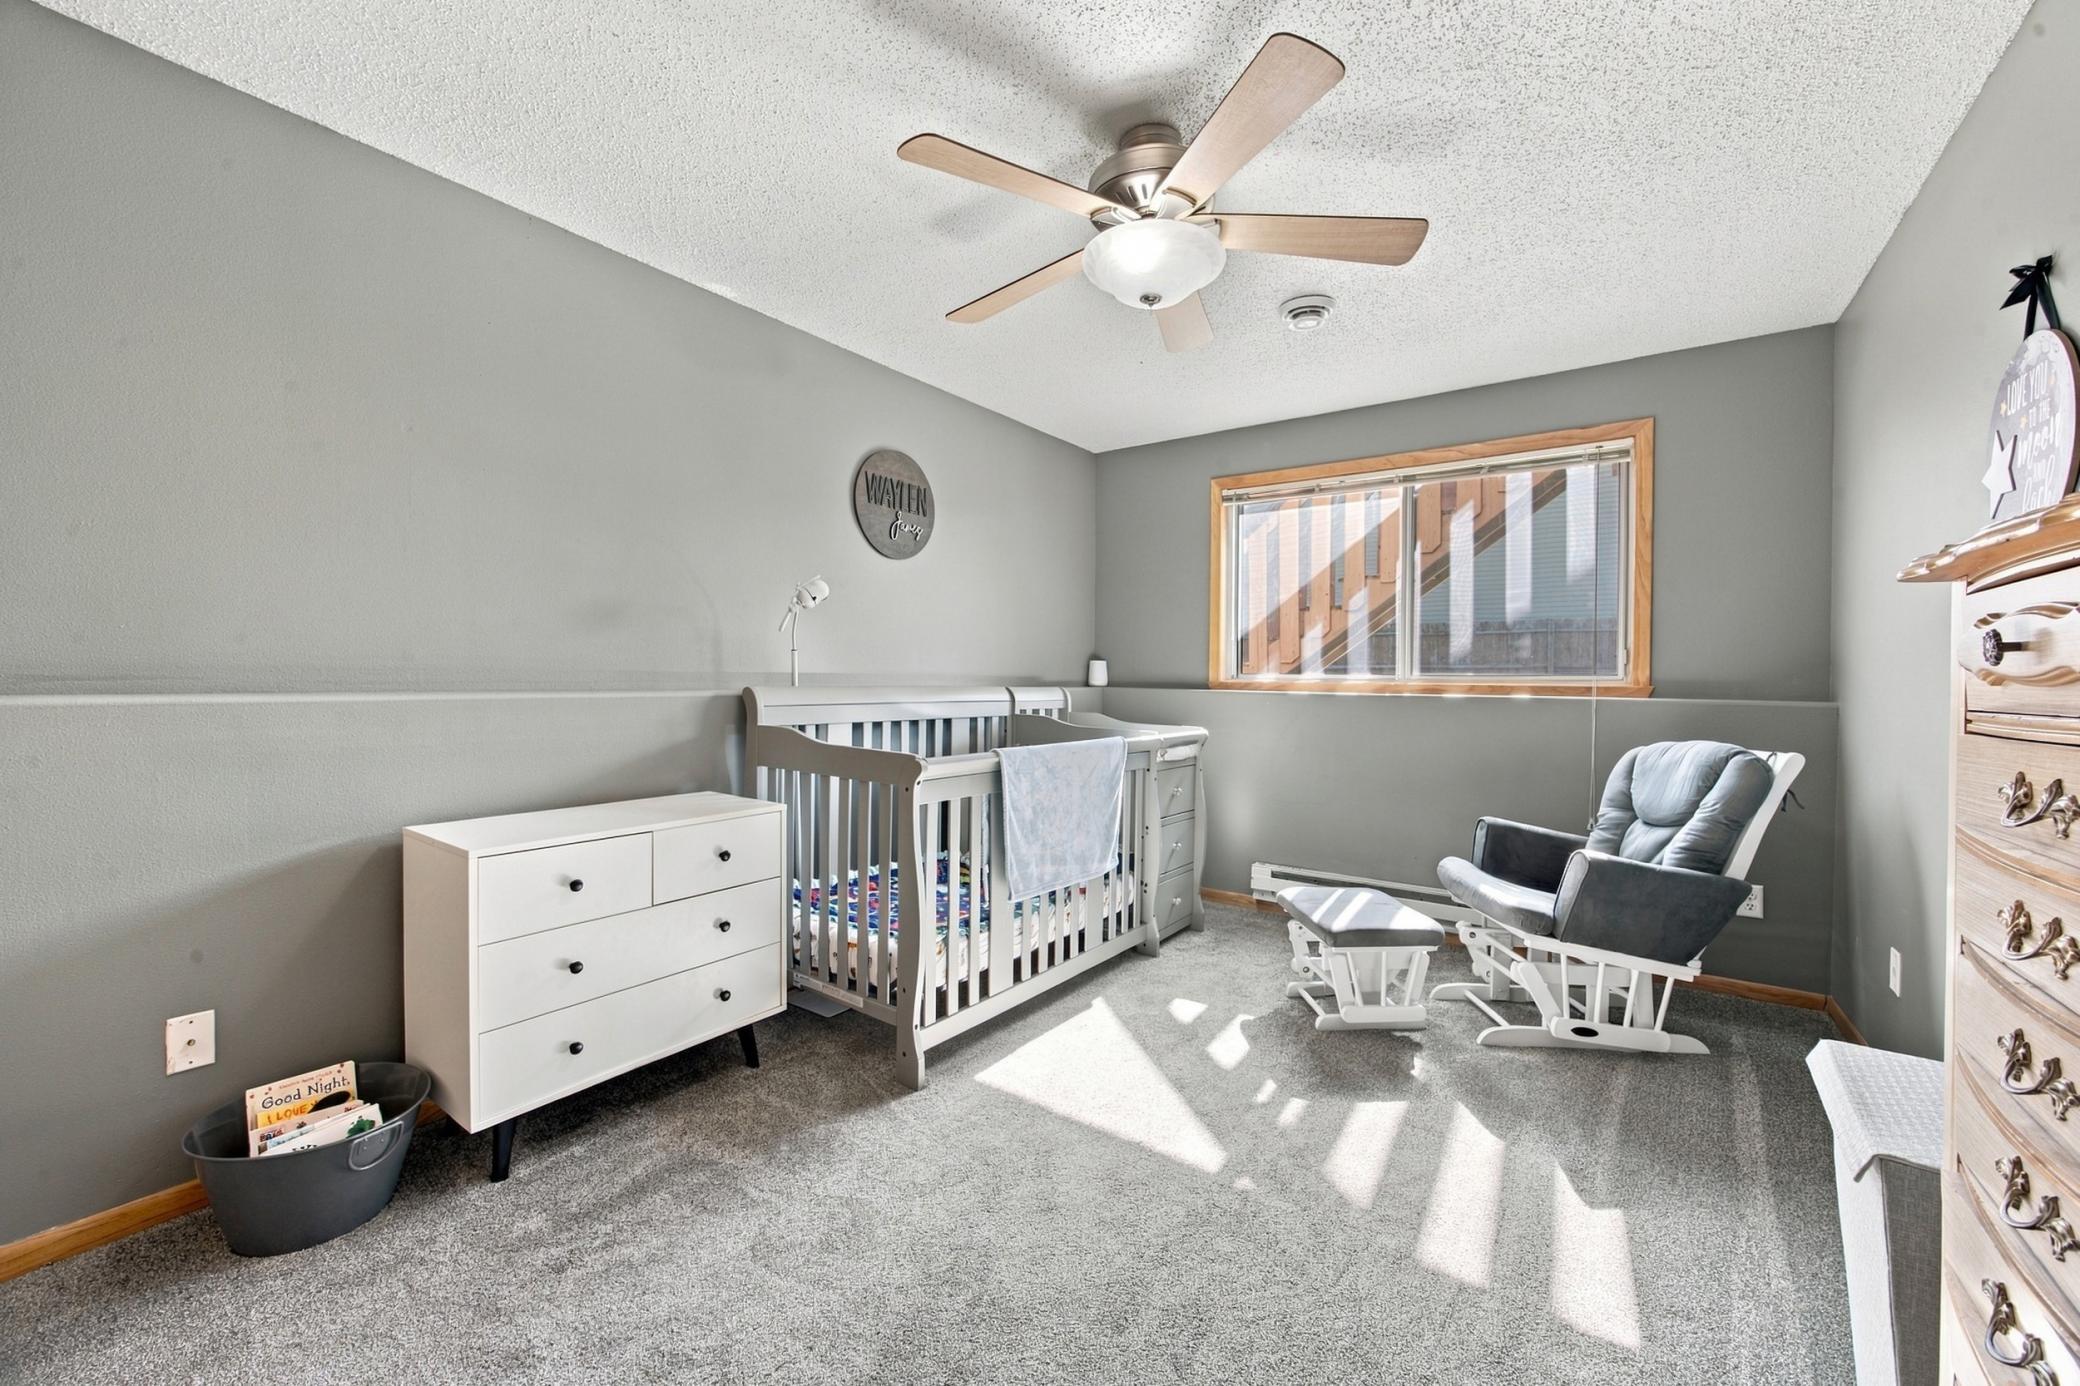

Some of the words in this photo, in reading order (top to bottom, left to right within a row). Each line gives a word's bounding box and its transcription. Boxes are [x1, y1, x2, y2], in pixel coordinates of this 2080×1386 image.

[2007, 373, 2027, 416] LOVE
[2029, 359, 2048, 402] YOU
[2029, 406, 2037, 429] TO
[2038, 398, 2050, 422] THE
[261, 1089, 301, 1110] Good
[276, 1103, 307, 1121] LOVE
